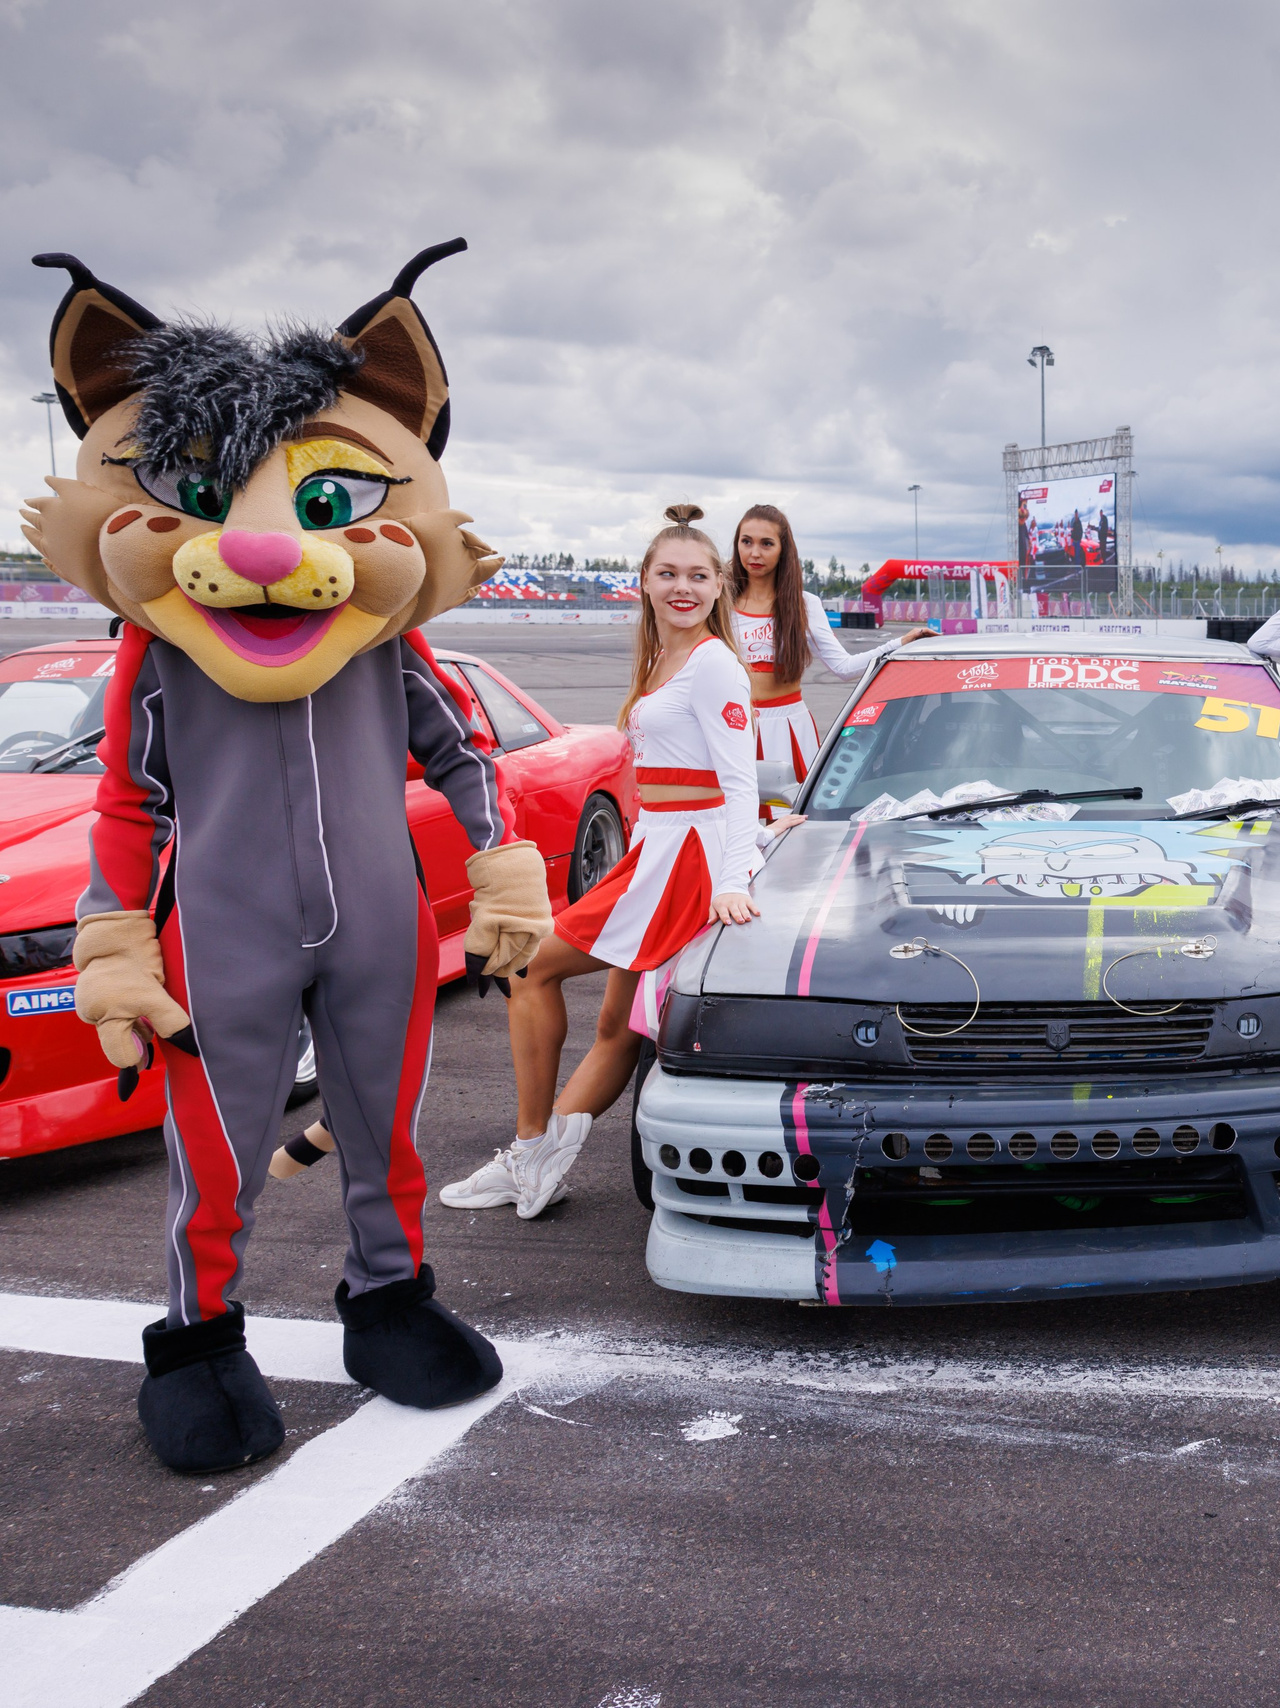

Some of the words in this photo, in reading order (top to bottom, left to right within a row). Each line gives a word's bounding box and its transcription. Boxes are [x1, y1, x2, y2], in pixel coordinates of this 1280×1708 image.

[1029, 658, 1081, 666] IGORA
[1090, 659, 1140, 668] DRIVE
[1028, 665, 1140, 685] IDDC
[1028, 681, 1065, 689] DRIFT
[1067, 682, 1141, 691] CHALLENGE
[1158, 679, 1217, 690] MATSURI
[12, 992, 74, 1011] AIMO
